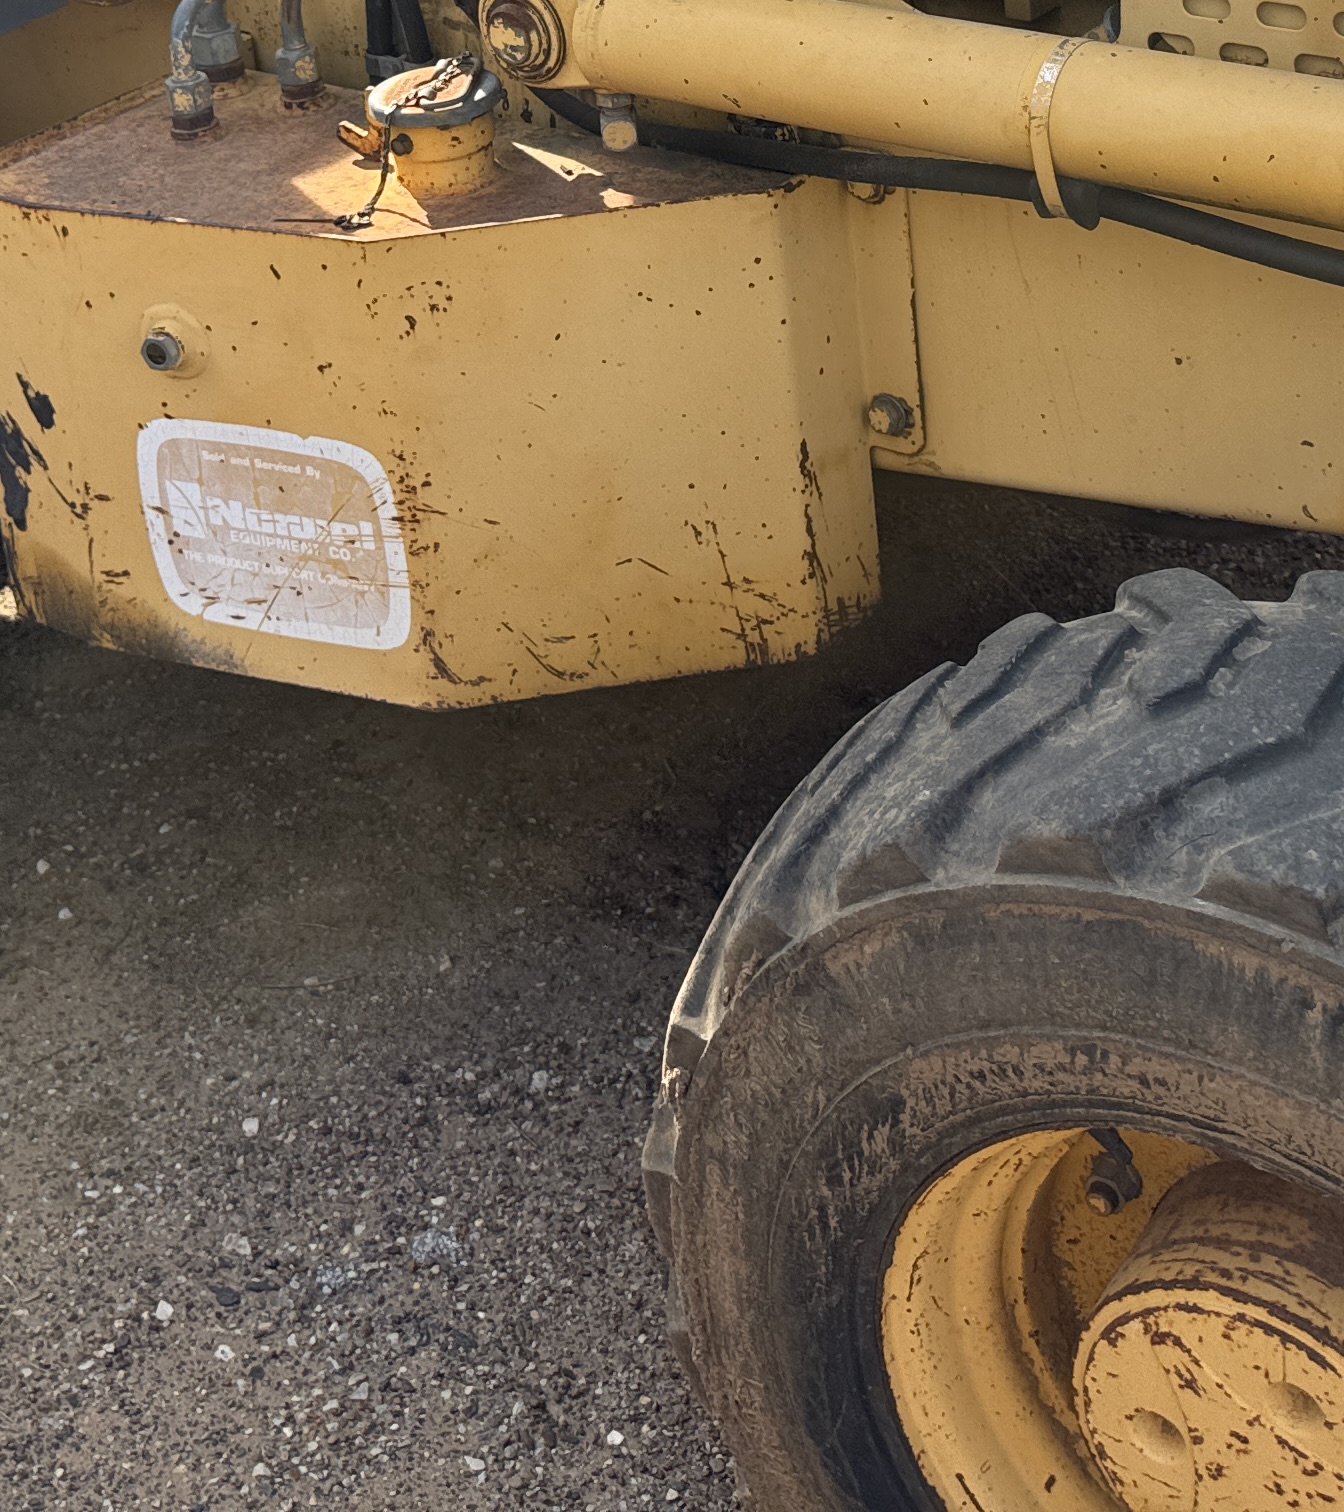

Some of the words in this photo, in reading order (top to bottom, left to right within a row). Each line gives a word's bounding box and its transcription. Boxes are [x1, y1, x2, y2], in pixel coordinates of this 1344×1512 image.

[202, 450, 226, 464] Sold
[230, 456, 250, 467] and
[254, 457, 302, 475] Serviced
[305, 465, 322, 480] By
[183, 549, 205, 562] THE
[206, 553, 261, 572] PRODUCT
[229, 529, 321, 557] EQUIPMENT
[328, 546, 357, 563] CO.
